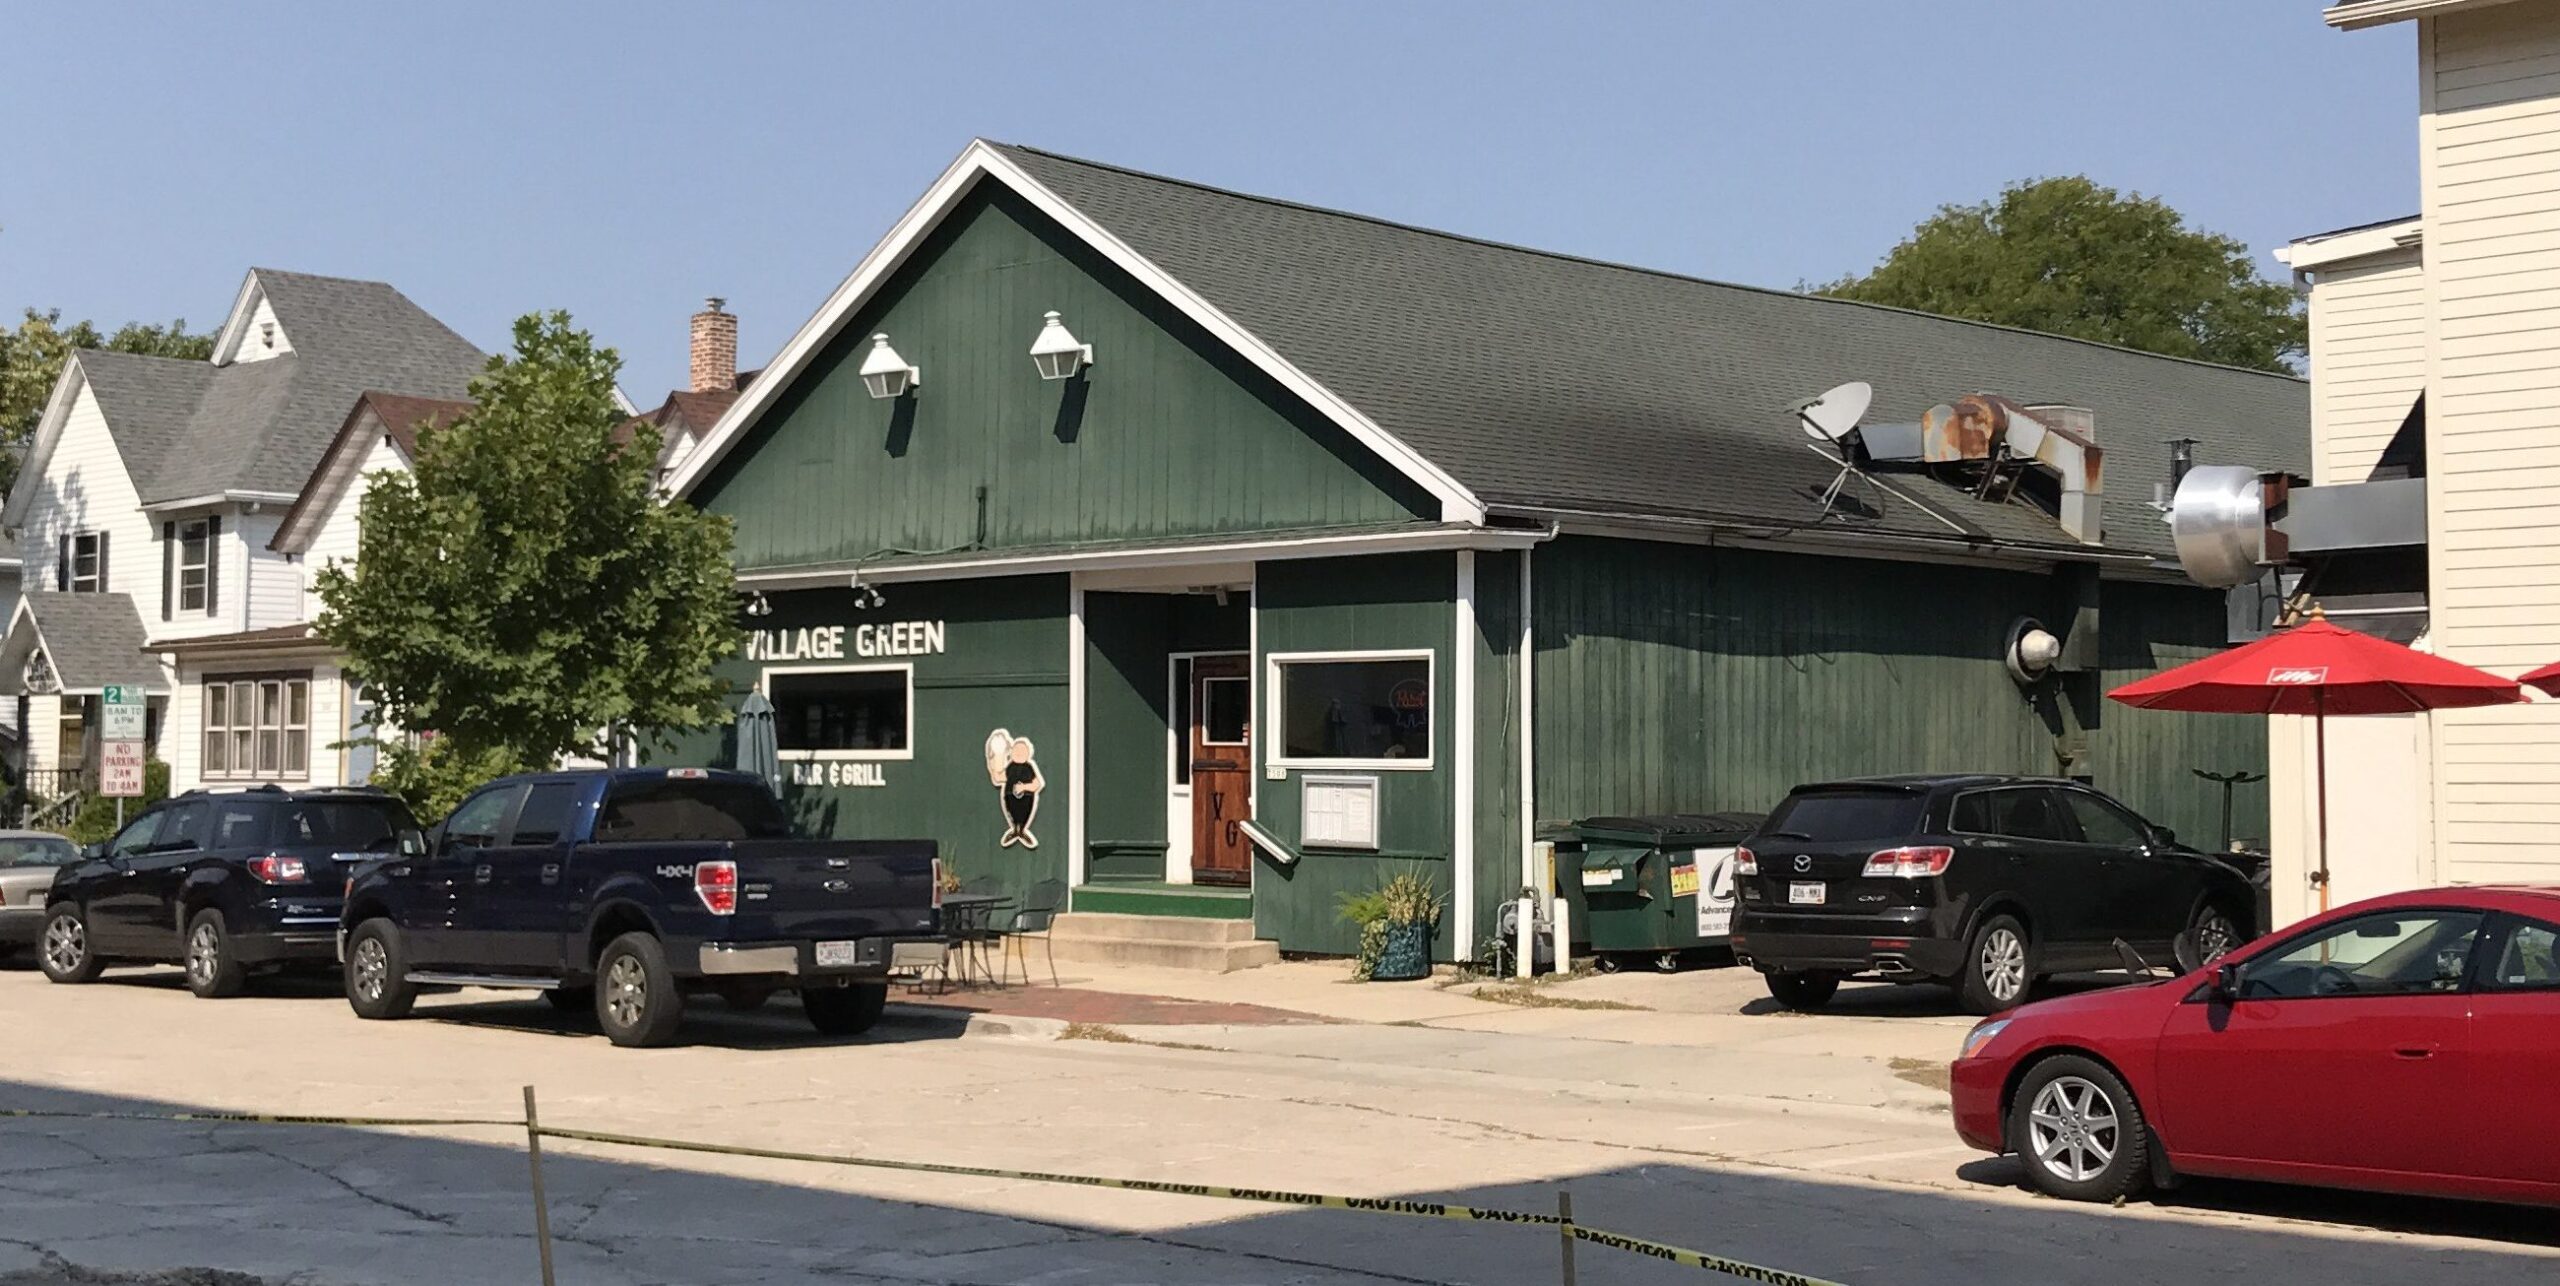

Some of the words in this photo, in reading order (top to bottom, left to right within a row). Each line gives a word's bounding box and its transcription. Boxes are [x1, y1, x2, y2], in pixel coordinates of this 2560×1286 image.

[746, 627, 845, 661] VILLAGE
[856, 620, 945, 657] GREEN
[108, 687, 118, 703] 2
[115, 743, 131, 754] NO
[105, 756, 142, 767] PARKING
[793, 763, 824, 786] BAR
[842, 763, 886, 786] GRILL
[106, 781, 117, 791] TO
[1211, 792, 1225, 822] V
[1225, 819, 1239, 848] G
[1701, 906, 1734, 915] Advance
